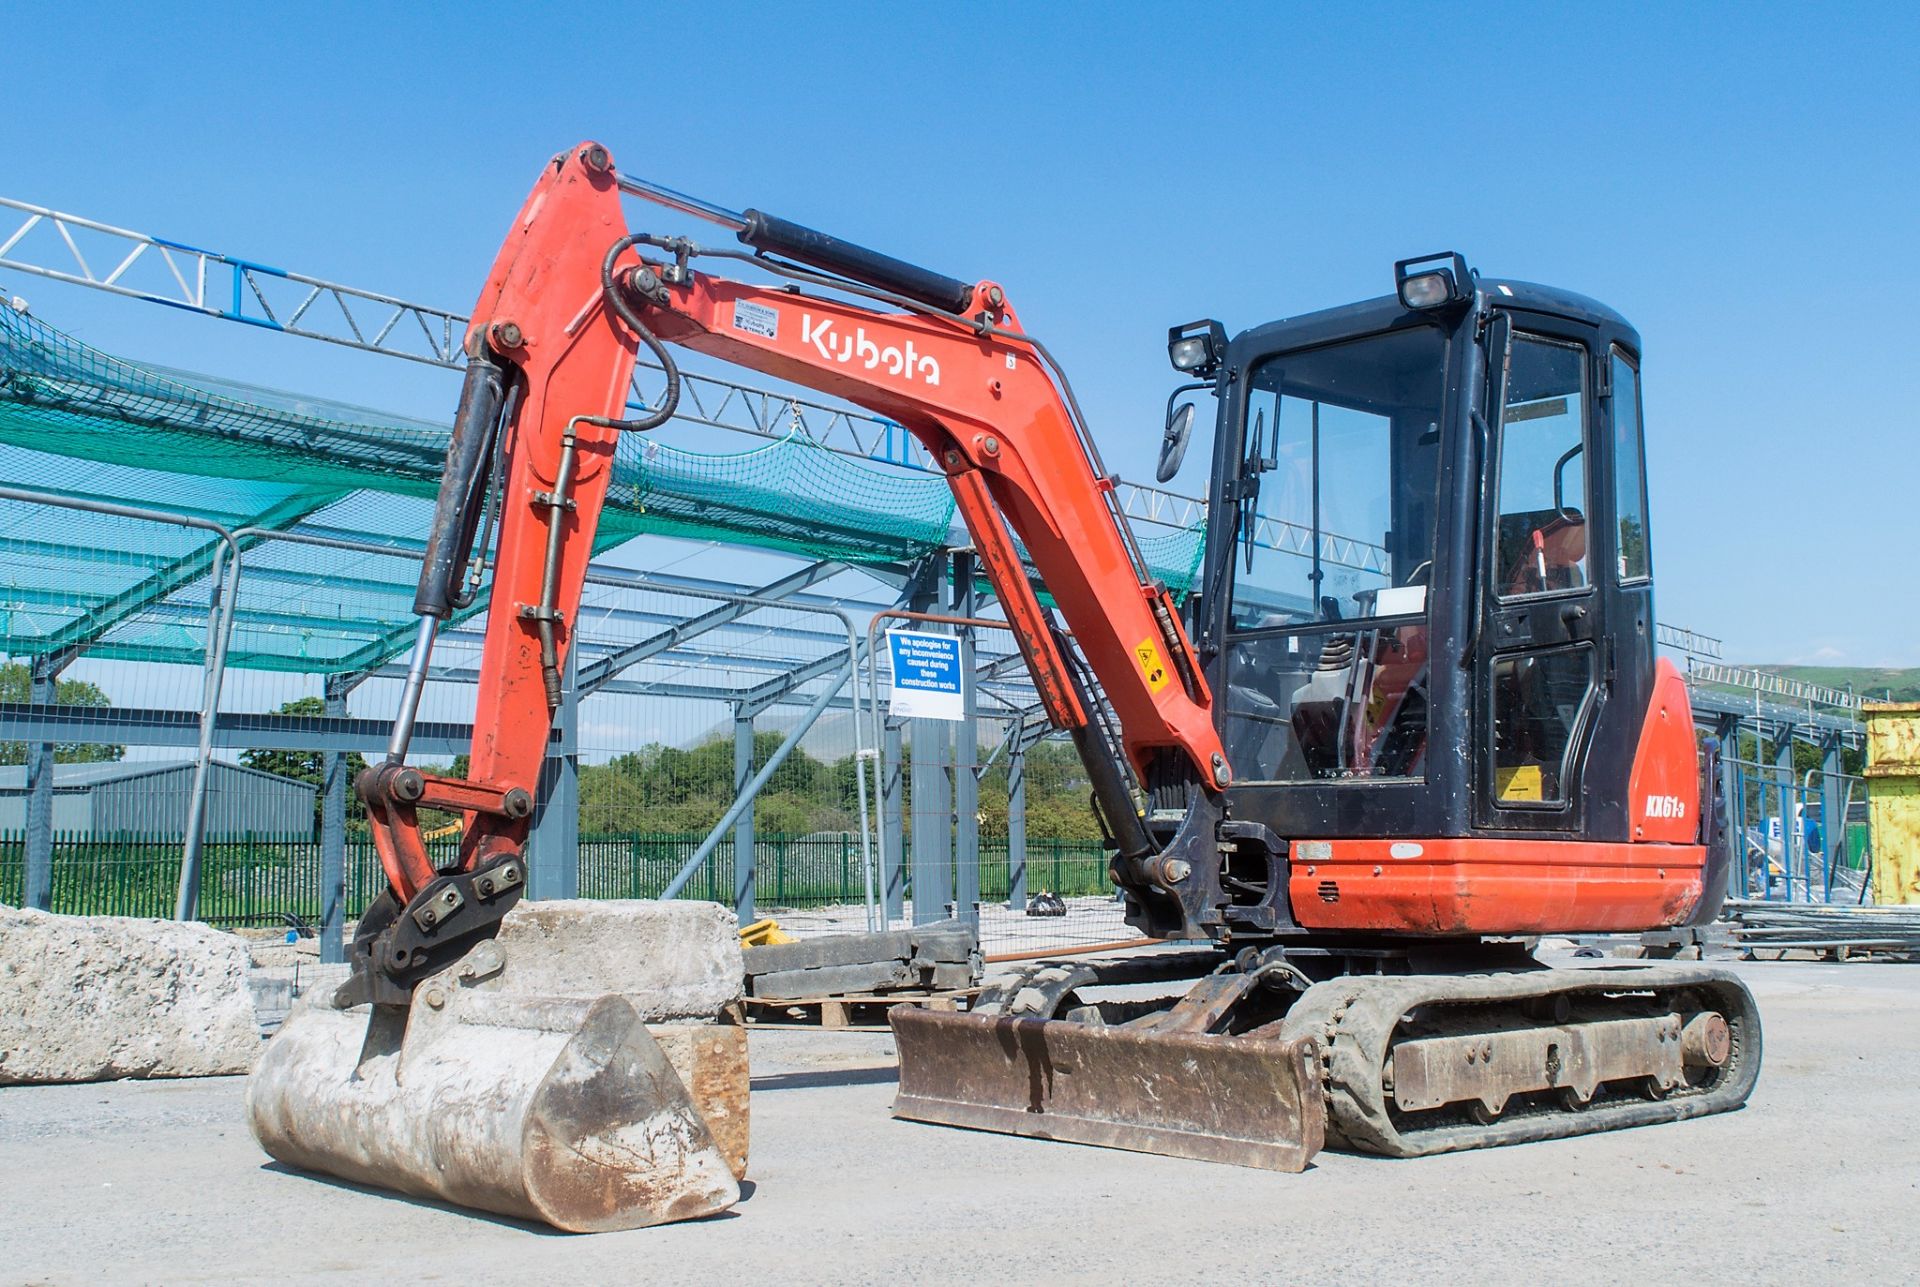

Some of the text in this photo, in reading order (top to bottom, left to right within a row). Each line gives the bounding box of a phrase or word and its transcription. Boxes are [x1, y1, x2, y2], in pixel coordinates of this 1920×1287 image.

[802, 313, 940, 386] Kubota
[900, 636, 951, 650] We apologise for
[899, 648, 954, 660] any inconvenience
[907, 659, 949, 671] caused during
[920, 669, 937, 678] these
[901, 678, 956, 690] construction works
